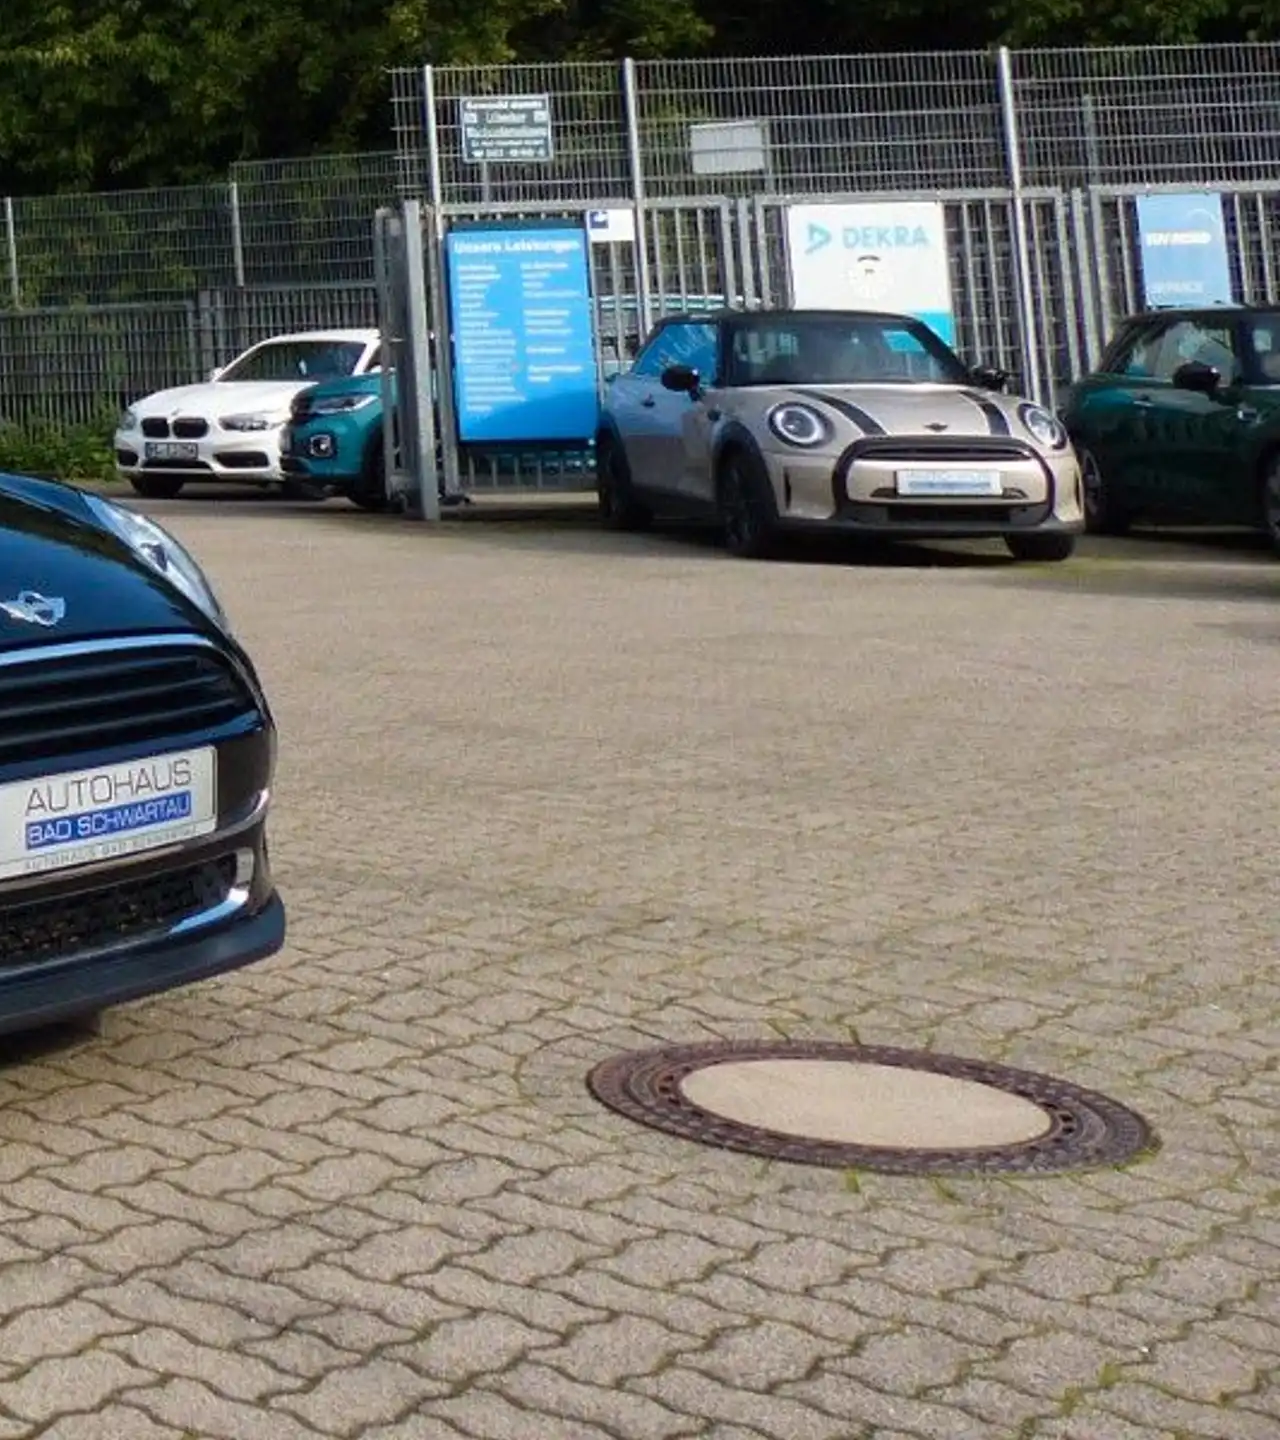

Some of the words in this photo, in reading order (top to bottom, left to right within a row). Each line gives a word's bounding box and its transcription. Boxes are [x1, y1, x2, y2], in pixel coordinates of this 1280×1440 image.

[842, 225, 929, 250] DEKRA
[25, 758, 192, 816] AUTOHAUS
[28, 819, 72, 845] BAD
[76, 793, 191, 835] SCHWARTAU
